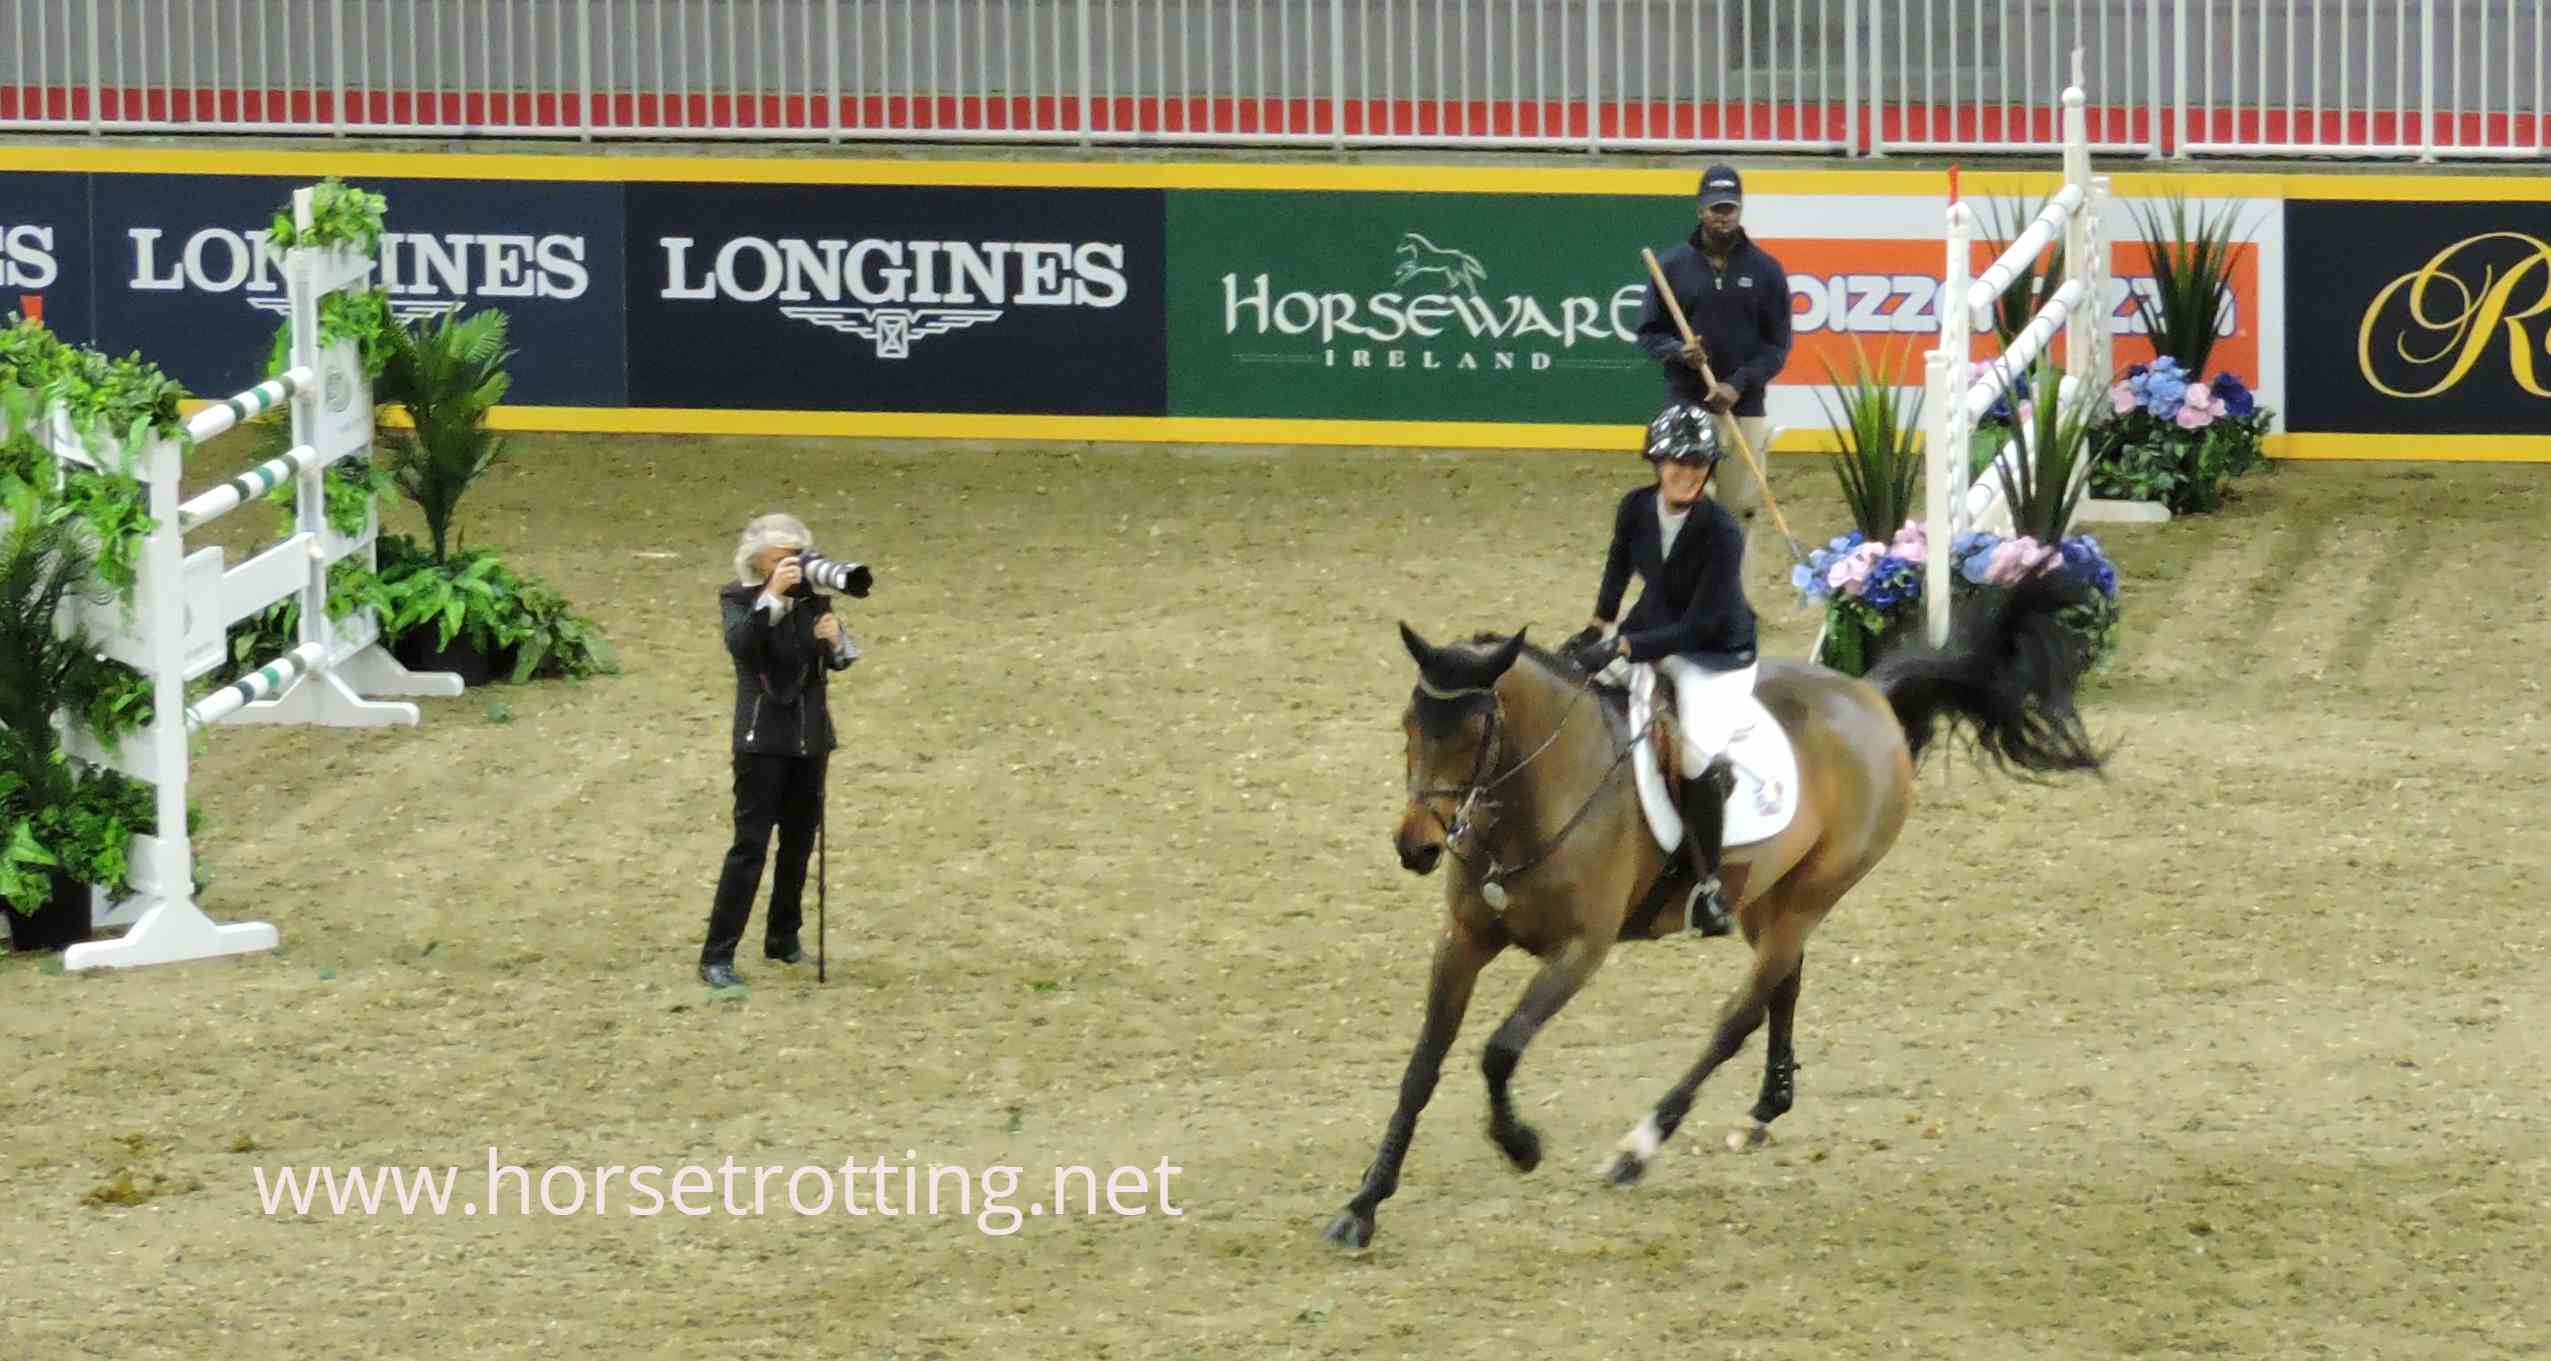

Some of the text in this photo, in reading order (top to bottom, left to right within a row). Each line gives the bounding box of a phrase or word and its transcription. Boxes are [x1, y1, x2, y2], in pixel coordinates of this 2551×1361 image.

[0, 225, 58, 288] S
[660, 237, 1128, 308] LONGINES
[2357, 232, 2551, 398] R
[1323, 349, 1553, 371] IRELAND
